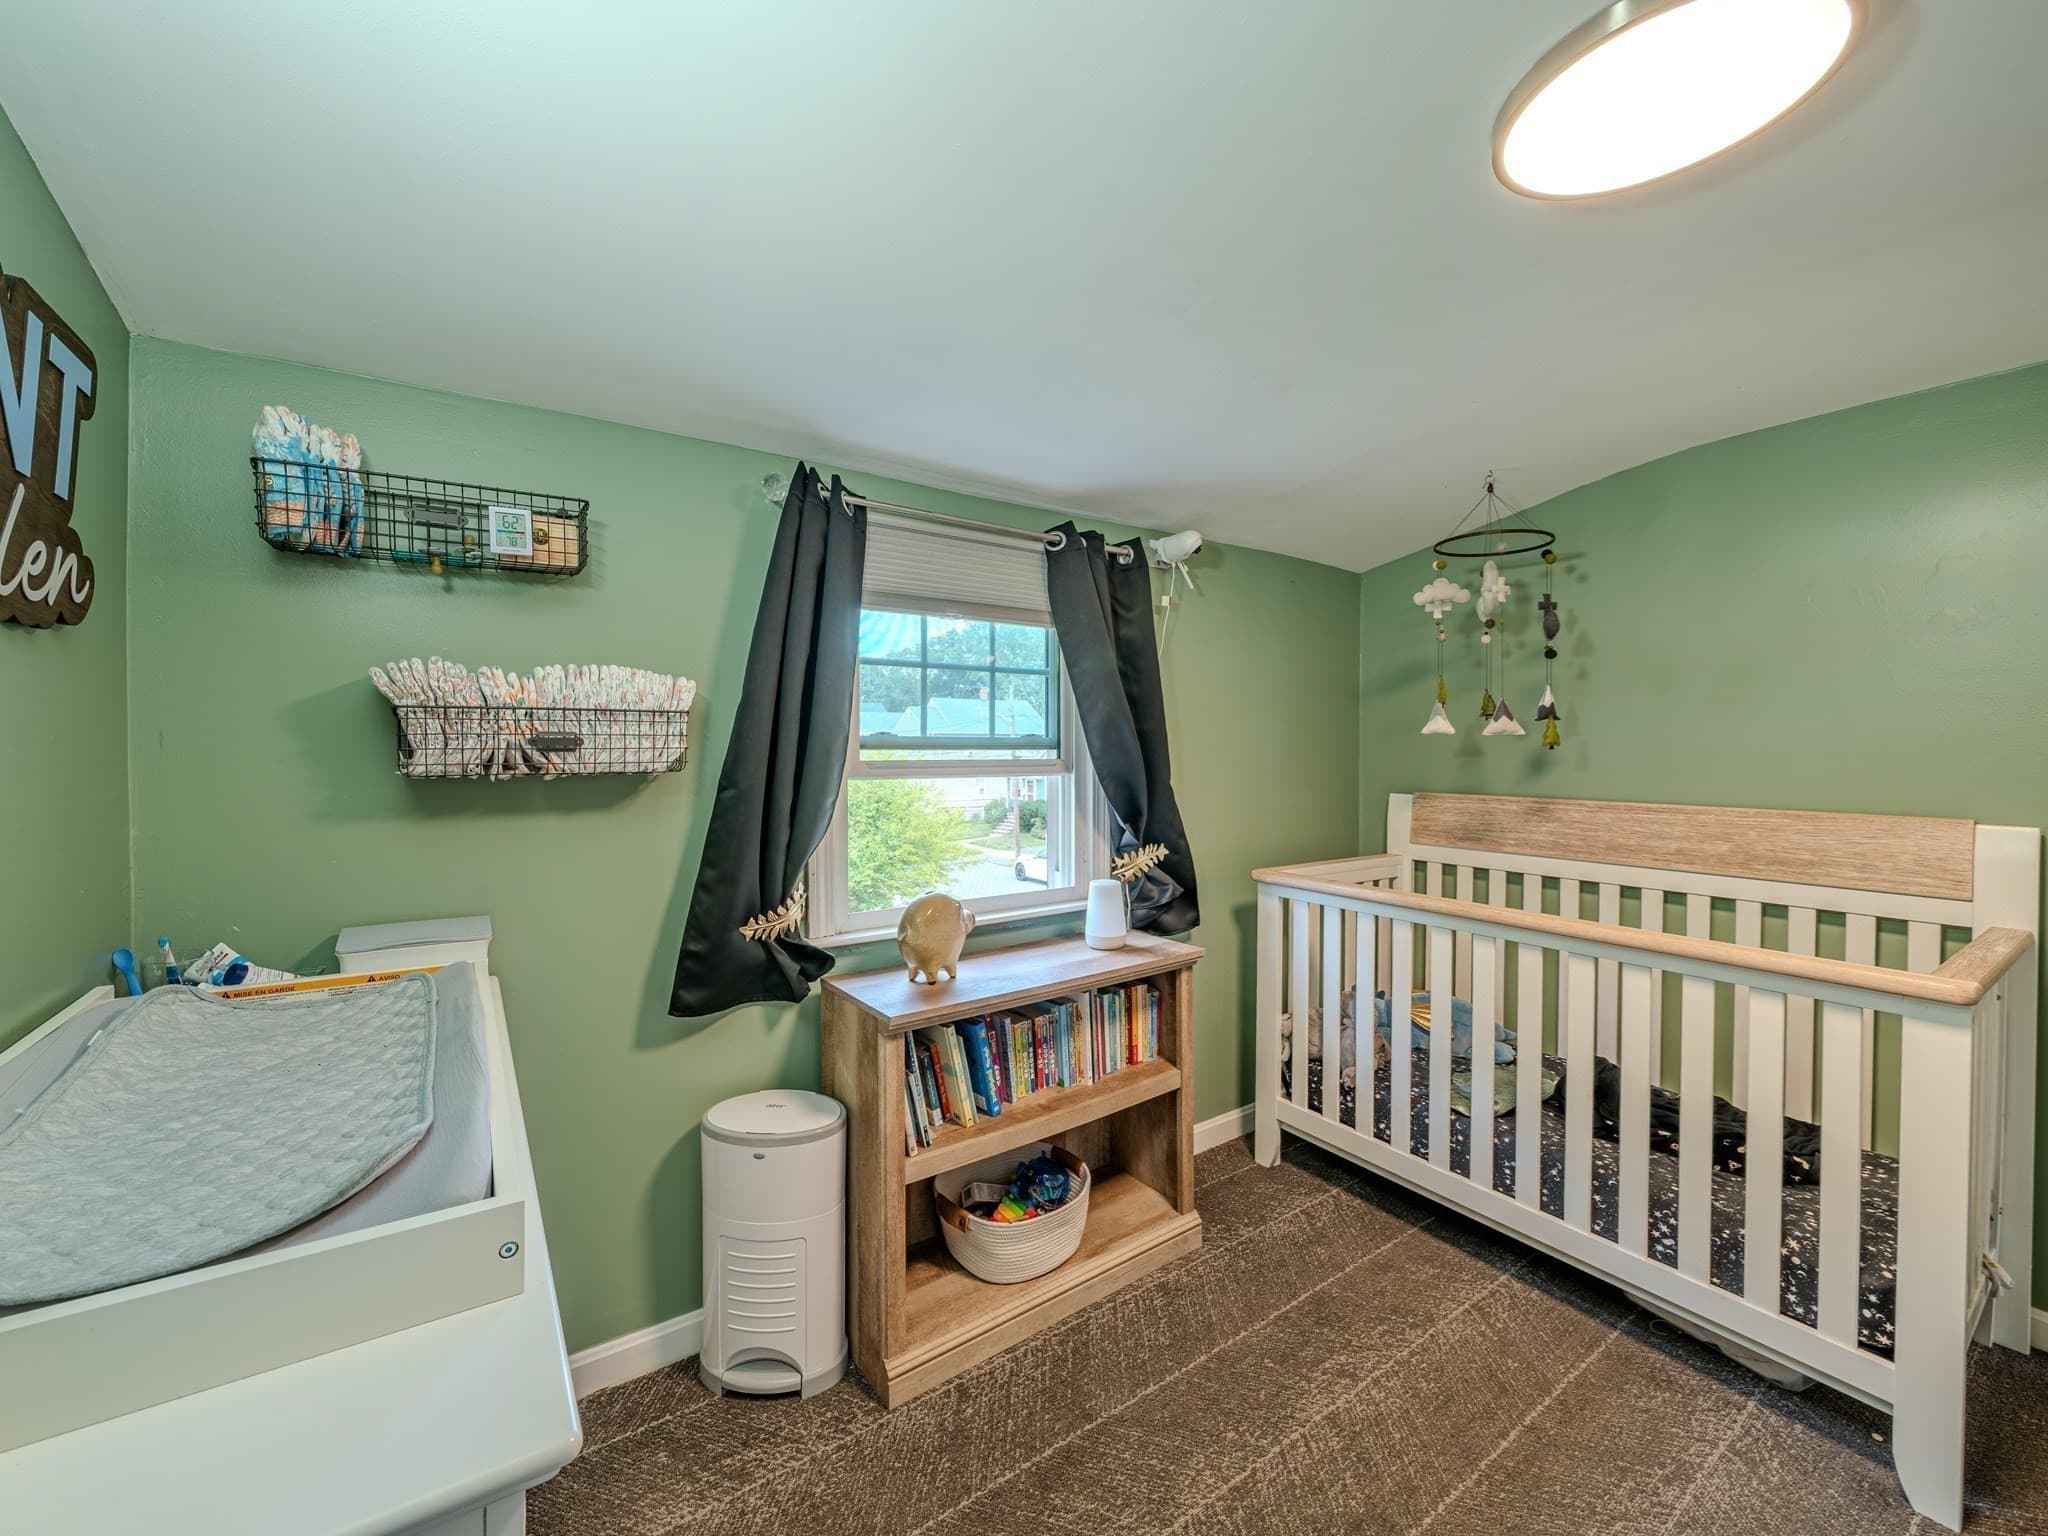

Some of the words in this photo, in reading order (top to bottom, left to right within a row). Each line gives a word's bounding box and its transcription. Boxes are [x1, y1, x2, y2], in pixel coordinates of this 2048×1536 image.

[502, 515, 518, 530] 62
[379, 974, 400, 982] AVISO
[233, 991, 253, 999] MISE
[268, 986, 296, 994] GARDE
